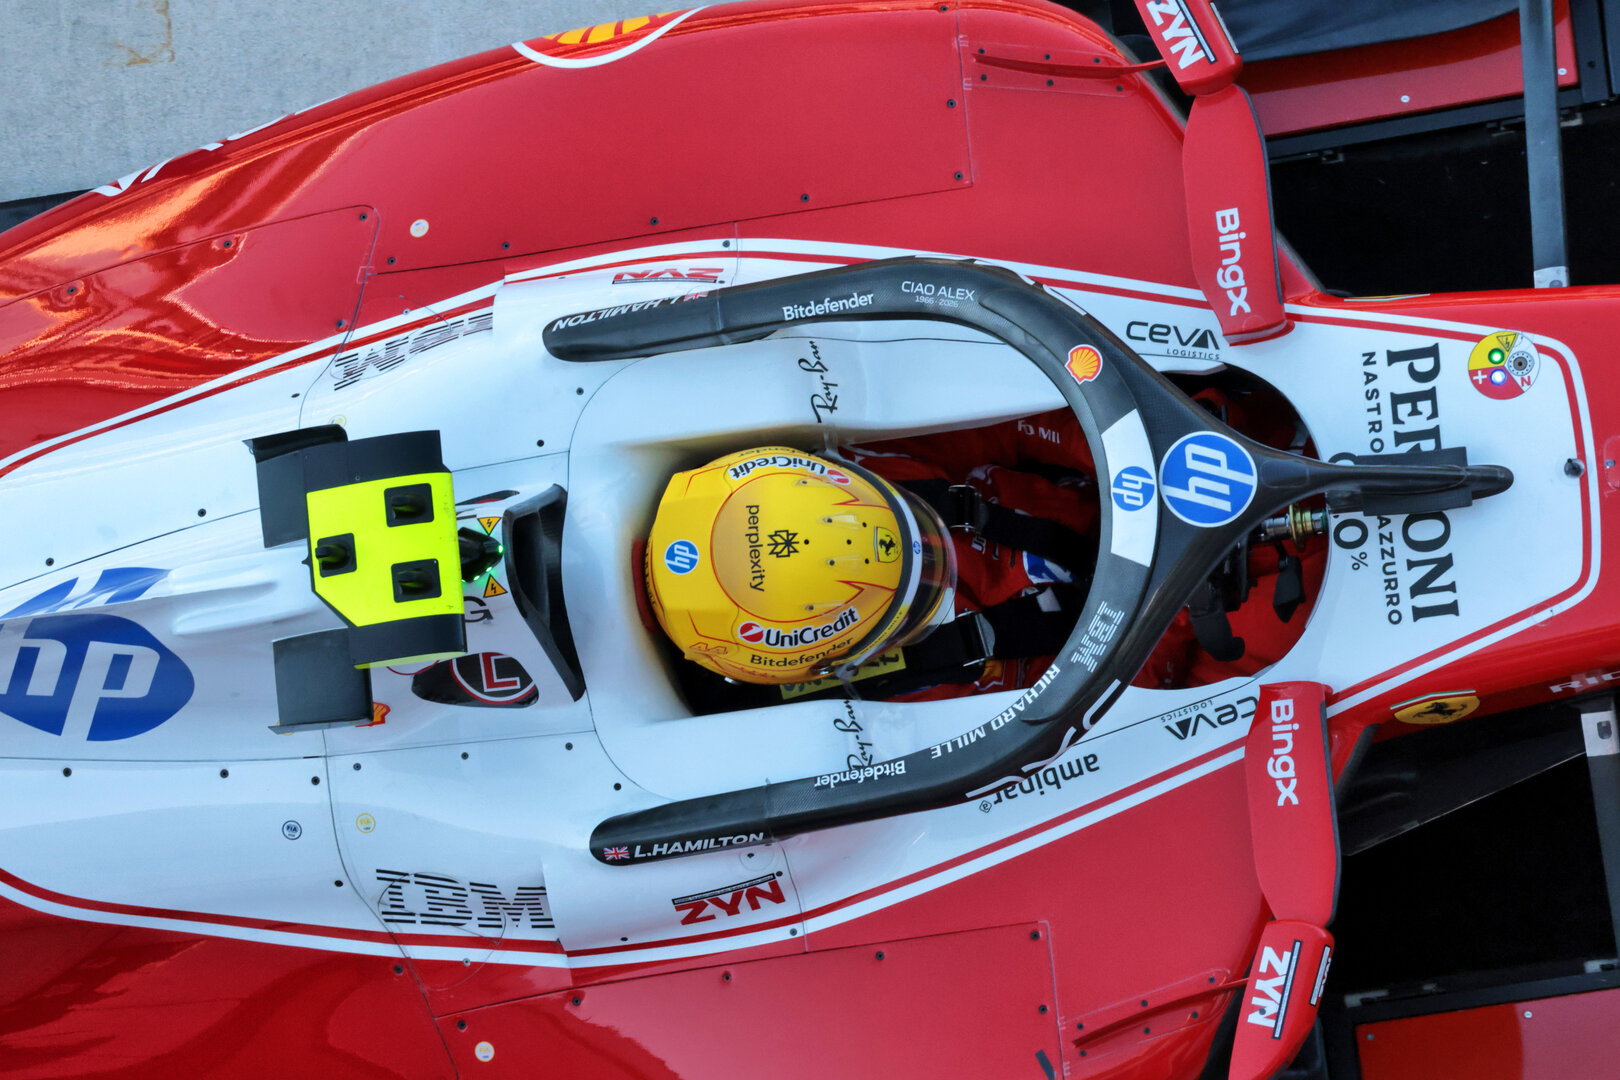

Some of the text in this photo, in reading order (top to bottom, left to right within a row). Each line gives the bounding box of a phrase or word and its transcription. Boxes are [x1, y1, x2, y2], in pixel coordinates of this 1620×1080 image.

[1146, 0, 1206, 70] ZYN
[782, 290, 875, 322] Bitdefender
[901, 280, 976, 301] CIAO ALEX
[1166, 348, 1221, 360] LOGISTICS
[798, 339, 839, 423] Ray-Ban
[729, 456, 826, 480] UniCredit
[1160, 441, 1257, 515] hp
[1111, 470, 1155, 509] hp
[1362, 351, 1403, 625] NASTRO AZZURRO
[665, 541, 699, 573] hp
[745, 504, 765, 592] perplexity
[764, 608, 859, 647] UniCredit
[1070, 600, 1126, 673] IBM
[750, 636, 855, 668] Bitdefender
[990, 663, 1061, 731] RICHARD
[1160, 699, 1214, 723] LOGISTICS
[930, 726, 987, 759] MILLE
[814, 760, 907, 789] Bitdefender
[633, 832, 767, 859] L.HAMILTON
[376, 868, 556, 929] IBM
[674, 879, 787, 926] ZYN
[1247, 945, 1292, 1029] ZYN
